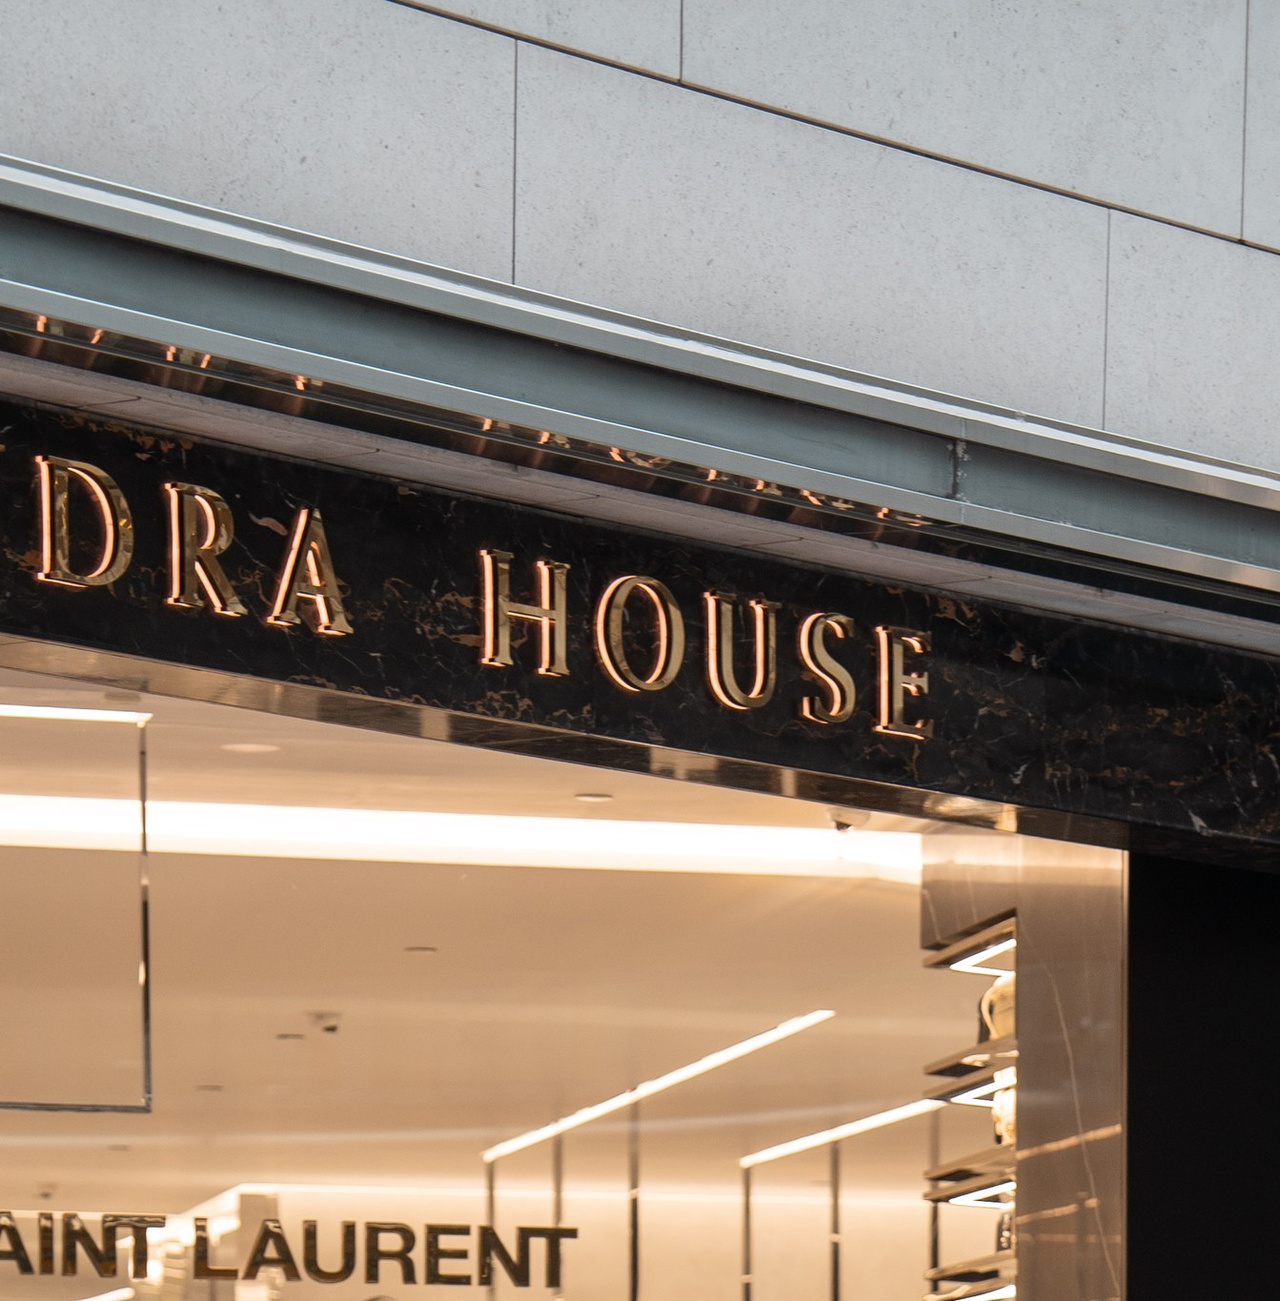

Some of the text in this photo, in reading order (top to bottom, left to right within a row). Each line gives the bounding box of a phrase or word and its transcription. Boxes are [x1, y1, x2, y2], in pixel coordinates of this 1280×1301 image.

[35, 454, 935, 740] DRA HOUSE
[193, 1217, 578, 1288] LAURENT
